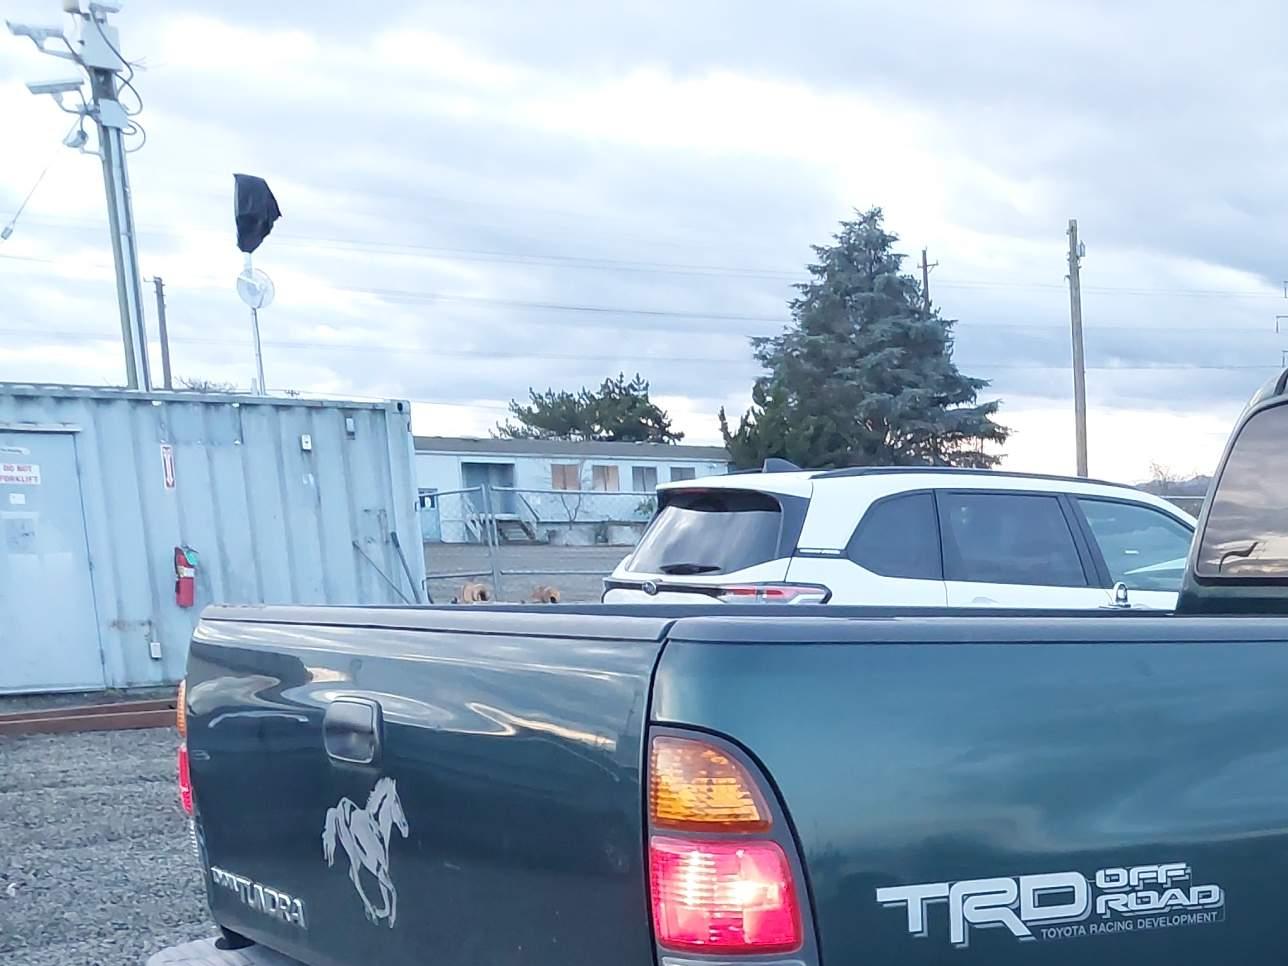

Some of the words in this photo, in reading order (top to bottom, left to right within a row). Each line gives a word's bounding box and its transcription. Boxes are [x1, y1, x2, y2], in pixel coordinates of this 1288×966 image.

[1095, 862, 1192, 891] OFF
[236, 877, 306, 929] TUNDRA
[875, 871, 1094, 948] TRD
[1095, 884, 1226, 918] ROAD
[1041, 925, 1087, 939] TOYOTA
[1089, 919, 1134, 934] RACING
[1137, 911, 1218, 929] DEVELOPMENT
